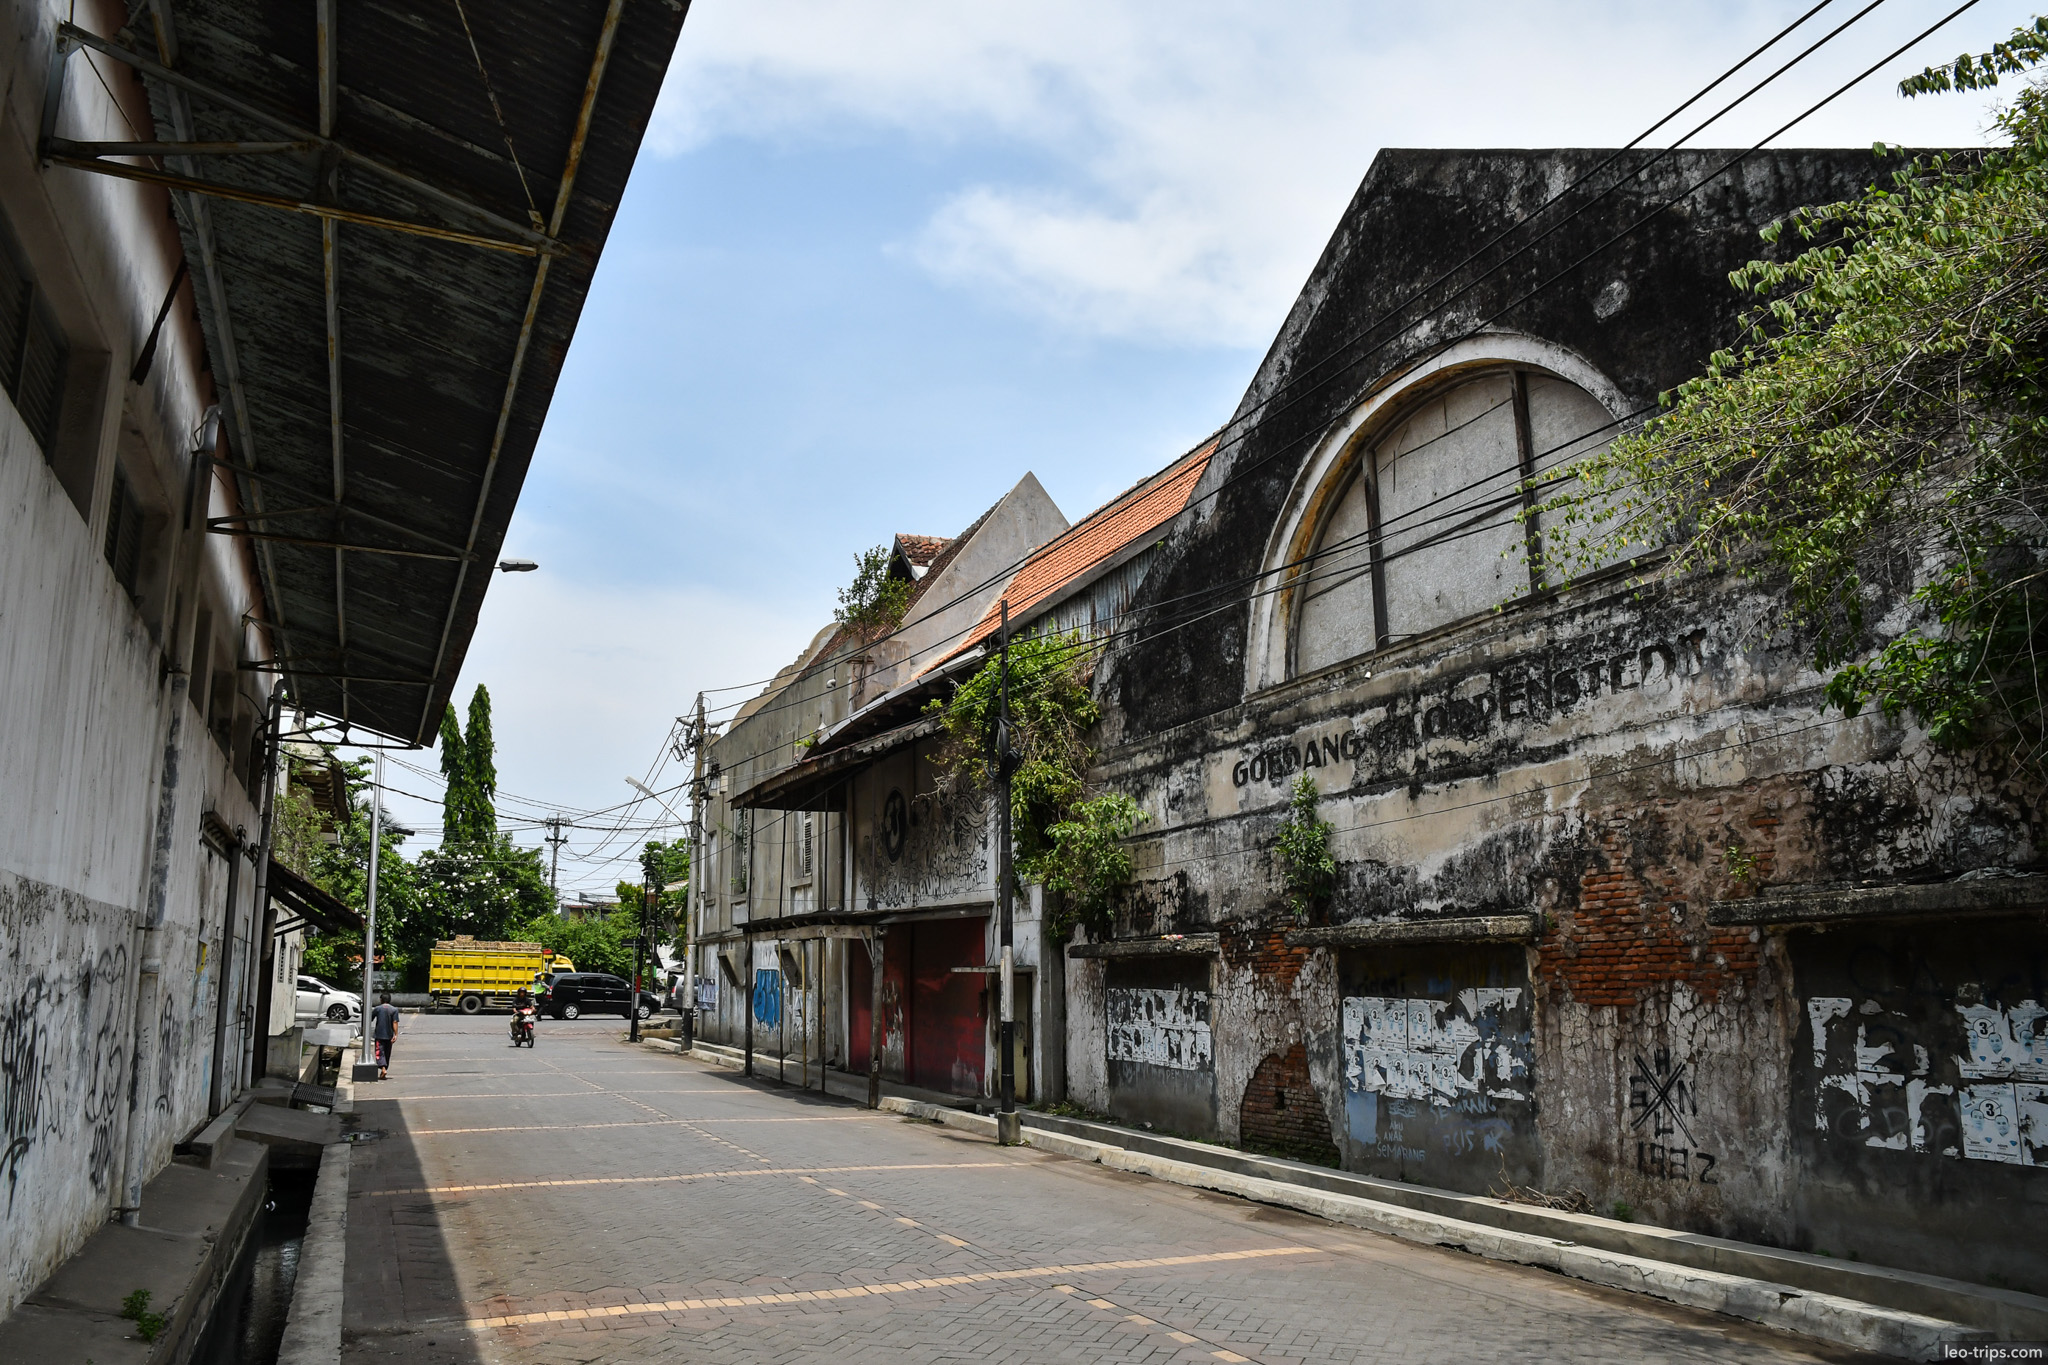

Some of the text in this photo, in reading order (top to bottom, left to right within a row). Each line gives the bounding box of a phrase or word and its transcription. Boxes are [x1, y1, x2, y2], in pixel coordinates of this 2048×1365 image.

[1232, 729, 1365, 788] GOEDANG
[1979, 1022, 1988, 1035] 3
[1985, 1103, 1995, 1117] 3
